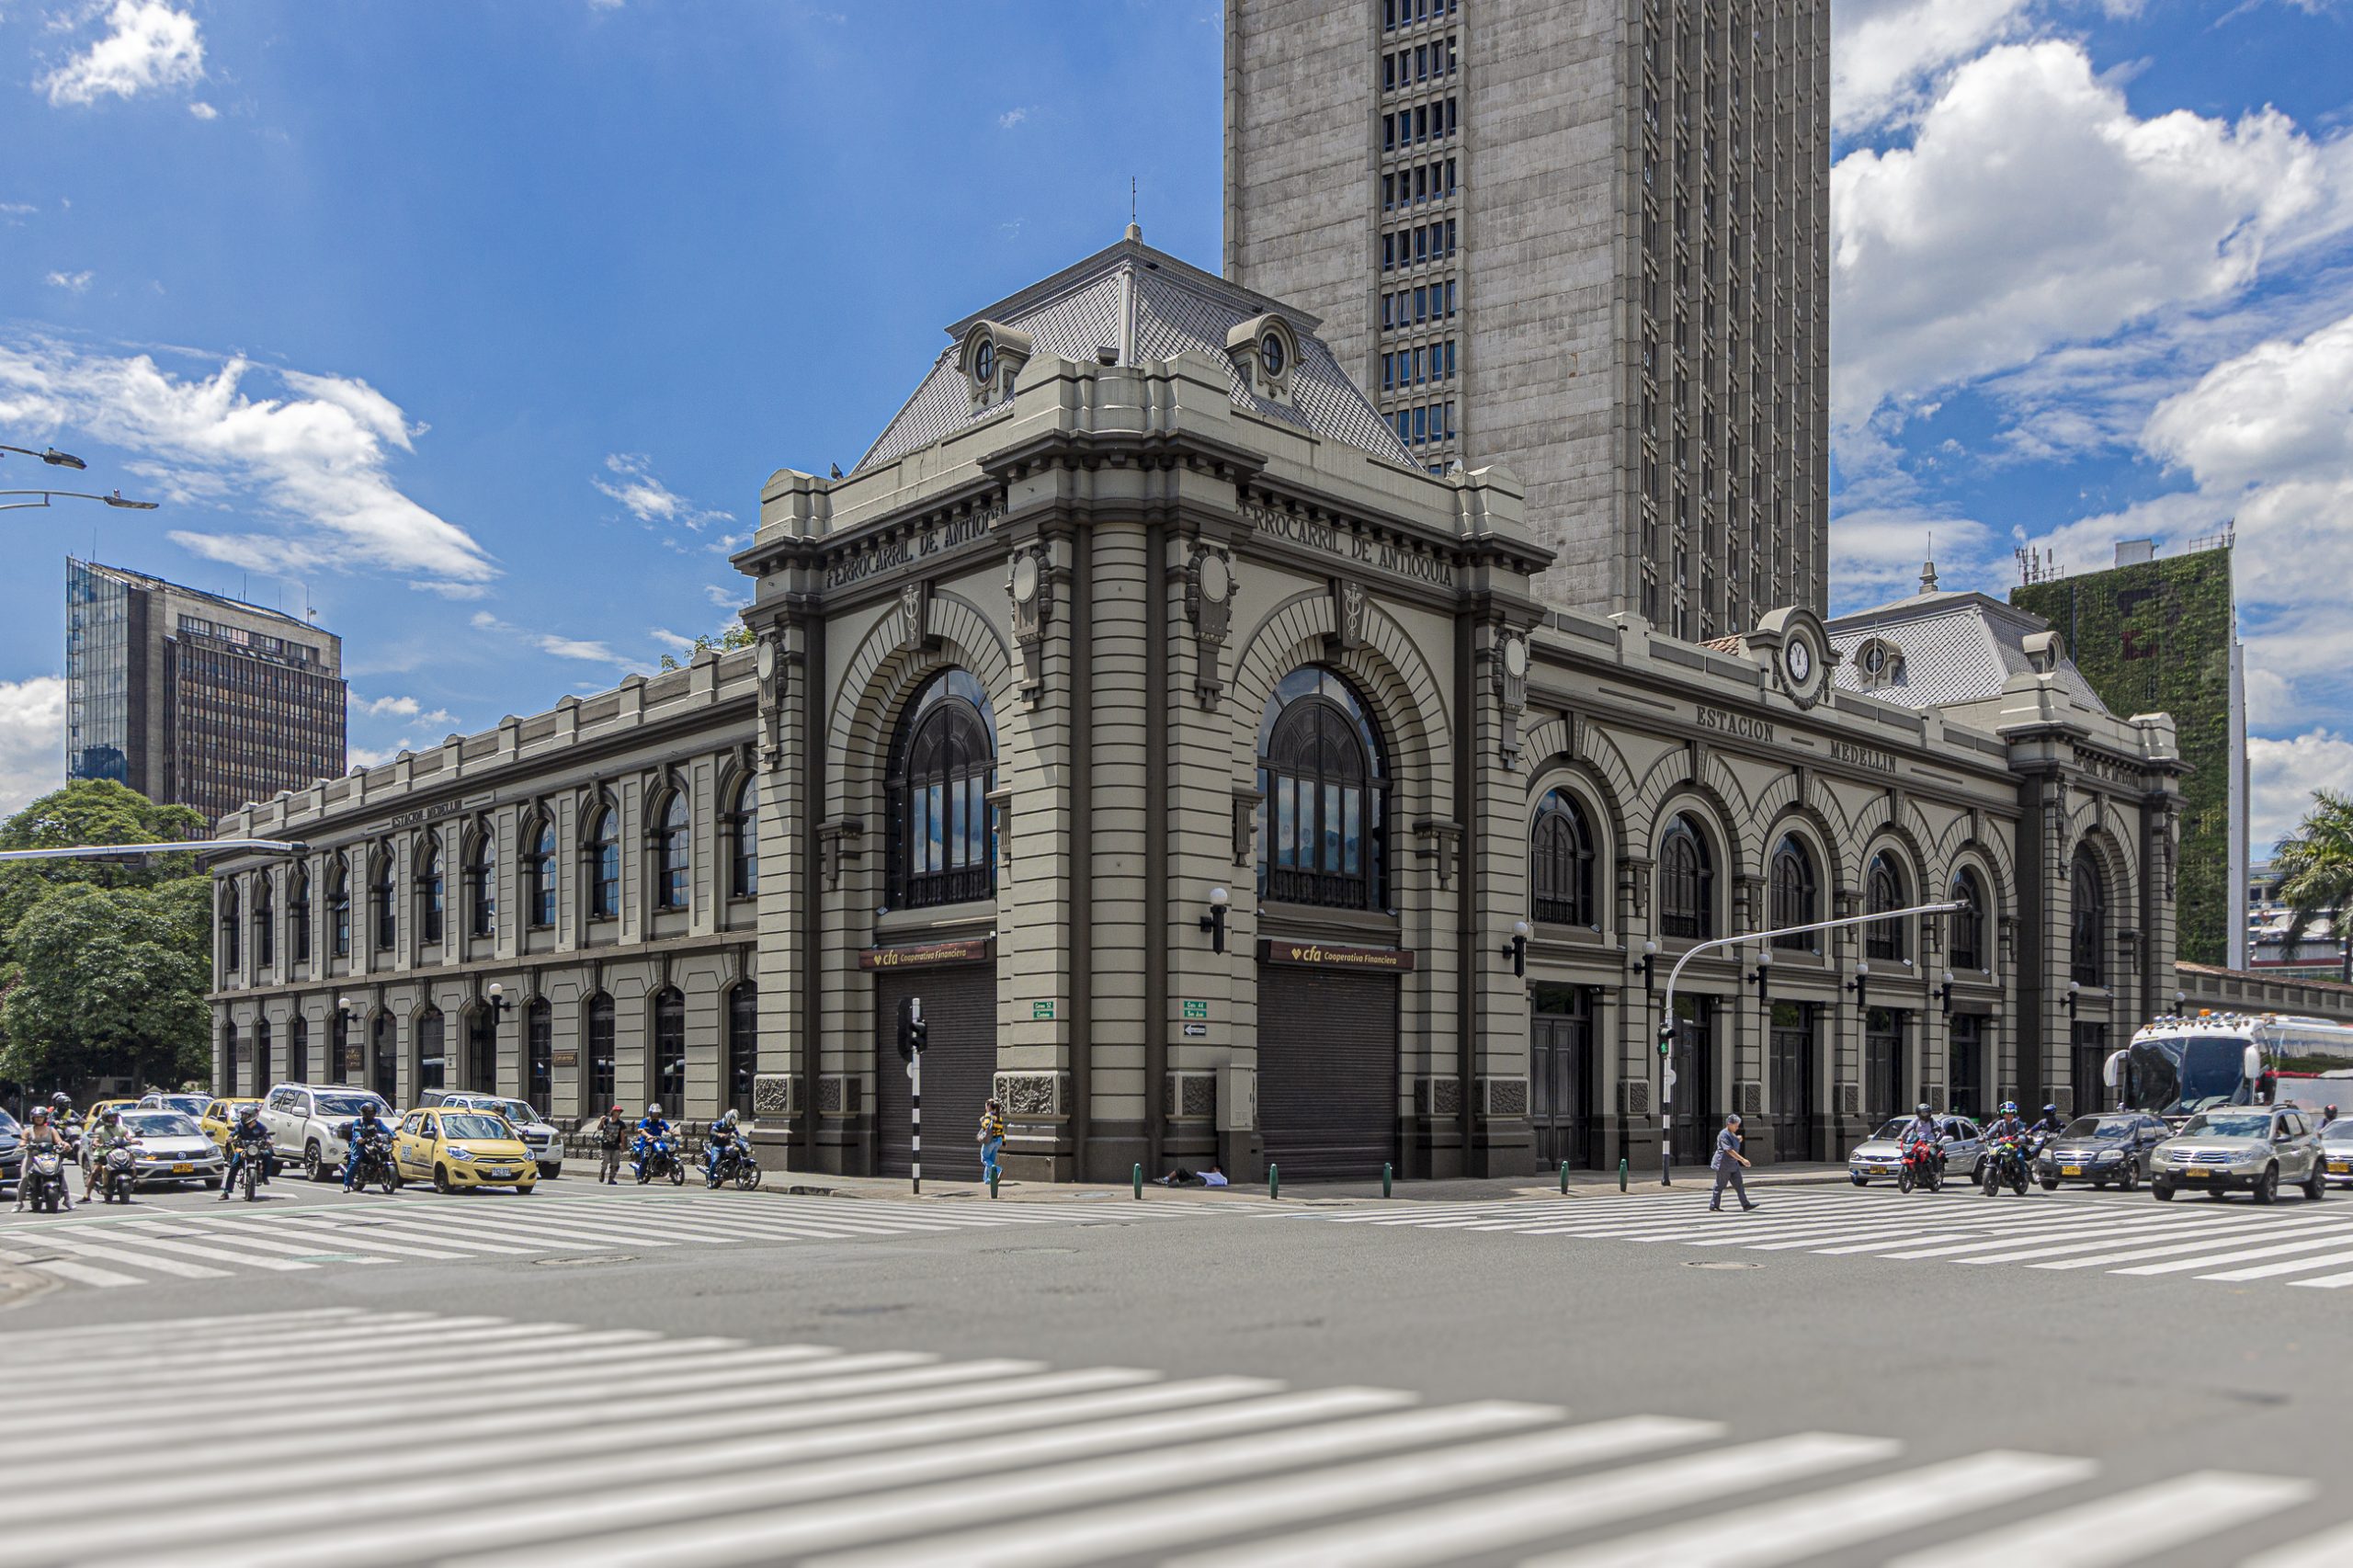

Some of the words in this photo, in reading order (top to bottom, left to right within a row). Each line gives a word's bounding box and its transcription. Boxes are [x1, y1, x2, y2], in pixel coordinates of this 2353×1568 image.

[826, 540, 913, 589] FERROCARRIL
[919, 529, 938, 556] DE
[1351, 536, 1372, 562] DE
[1379, 545, 1453, 587] ANTIOQUIA
[1696, 705, 1775, 744] ESTACION
[1830, 740, 1897, 774] MEDELLIN
[392, 809, 424, 828] ESTACION
[882, 949, 898, 965] cfa
[900, 950, 936, 963] Cooperativa
[935, 948, 967, 960] Financiera
[1302, 946, 1322, 962] cfa
[1324, 951, 1363, 963] Cooperativa
[1364, 954, 1397, 965] Financiera
